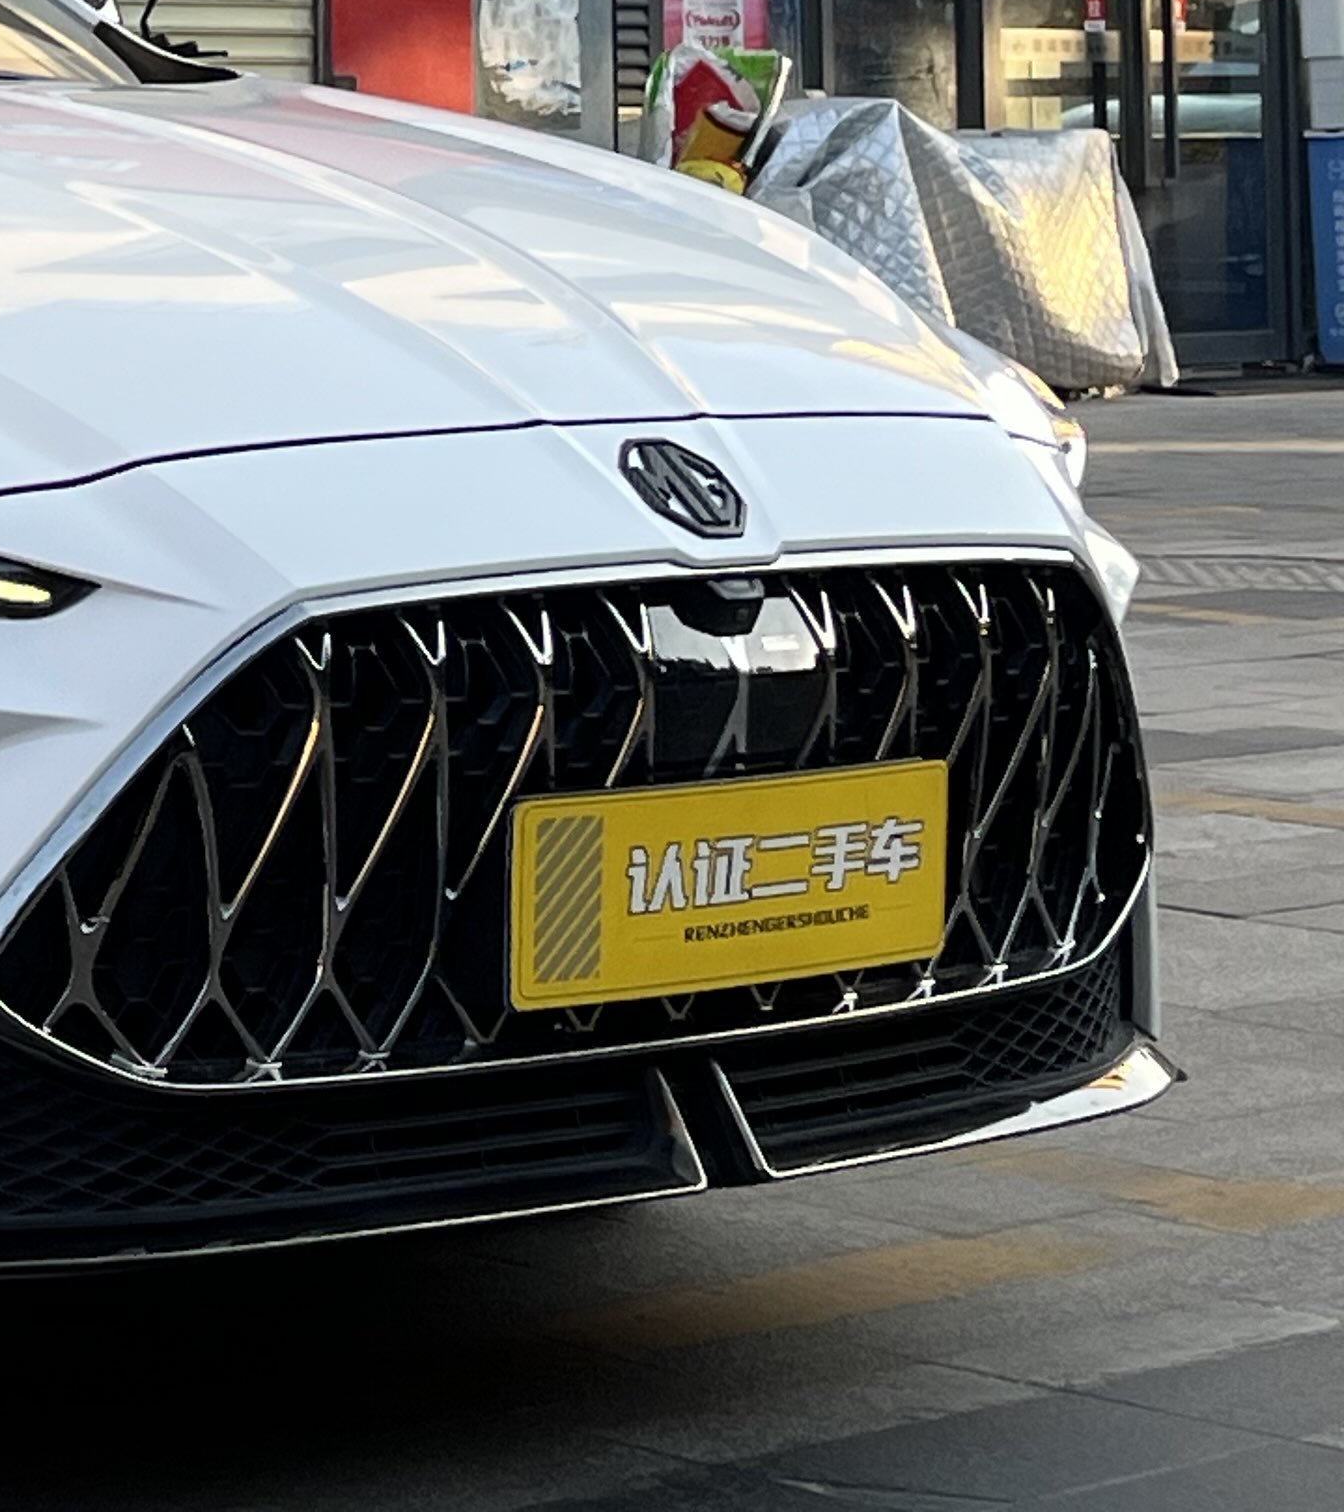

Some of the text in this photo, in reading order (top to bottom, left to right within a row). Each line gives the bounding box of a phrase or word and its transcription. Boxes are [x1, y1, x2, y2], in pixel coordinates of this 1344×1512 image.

[623, 440, 742, 531] MG
[625, 816, 925, 917] 认证二手车
